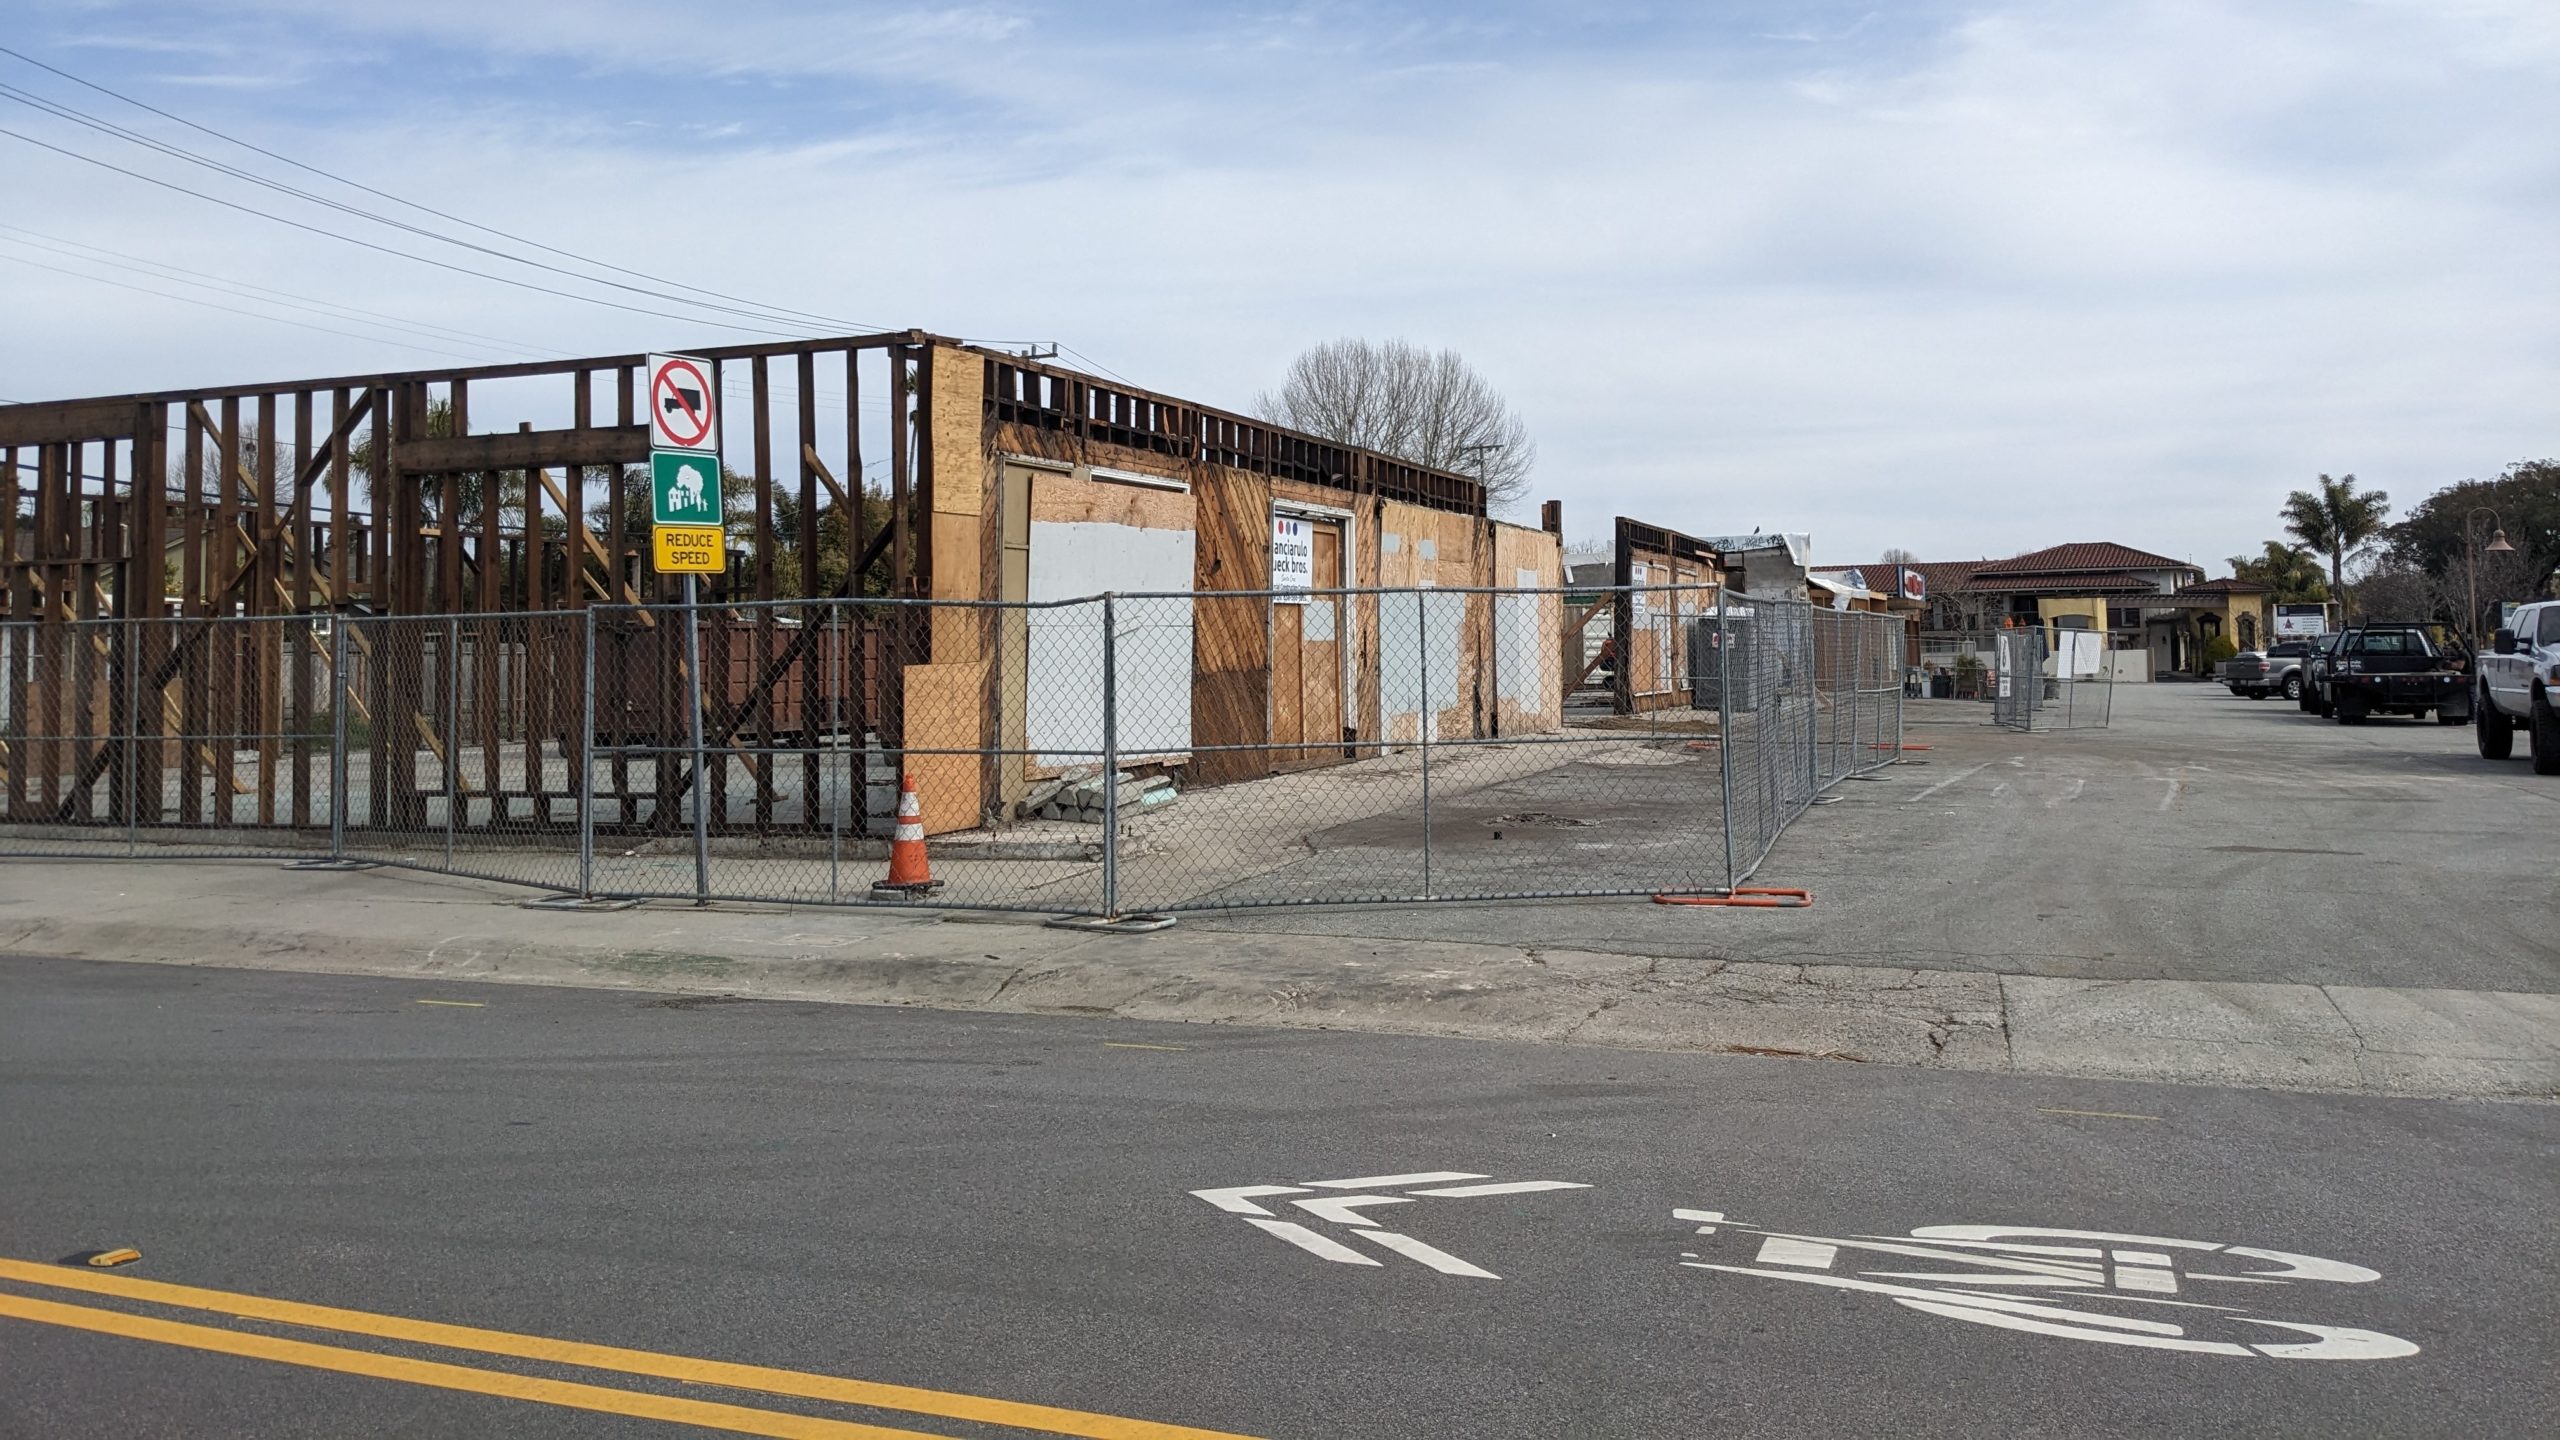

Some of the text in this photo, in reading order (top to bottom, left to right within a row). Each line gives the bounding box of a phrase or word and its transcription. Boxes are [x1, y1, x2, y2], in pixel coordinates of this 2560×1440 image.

[666, 533, 714, 547] REDUCE
[671, 551, 710, 565] SPEED
[1291, 557, 1308, 574] bros.
